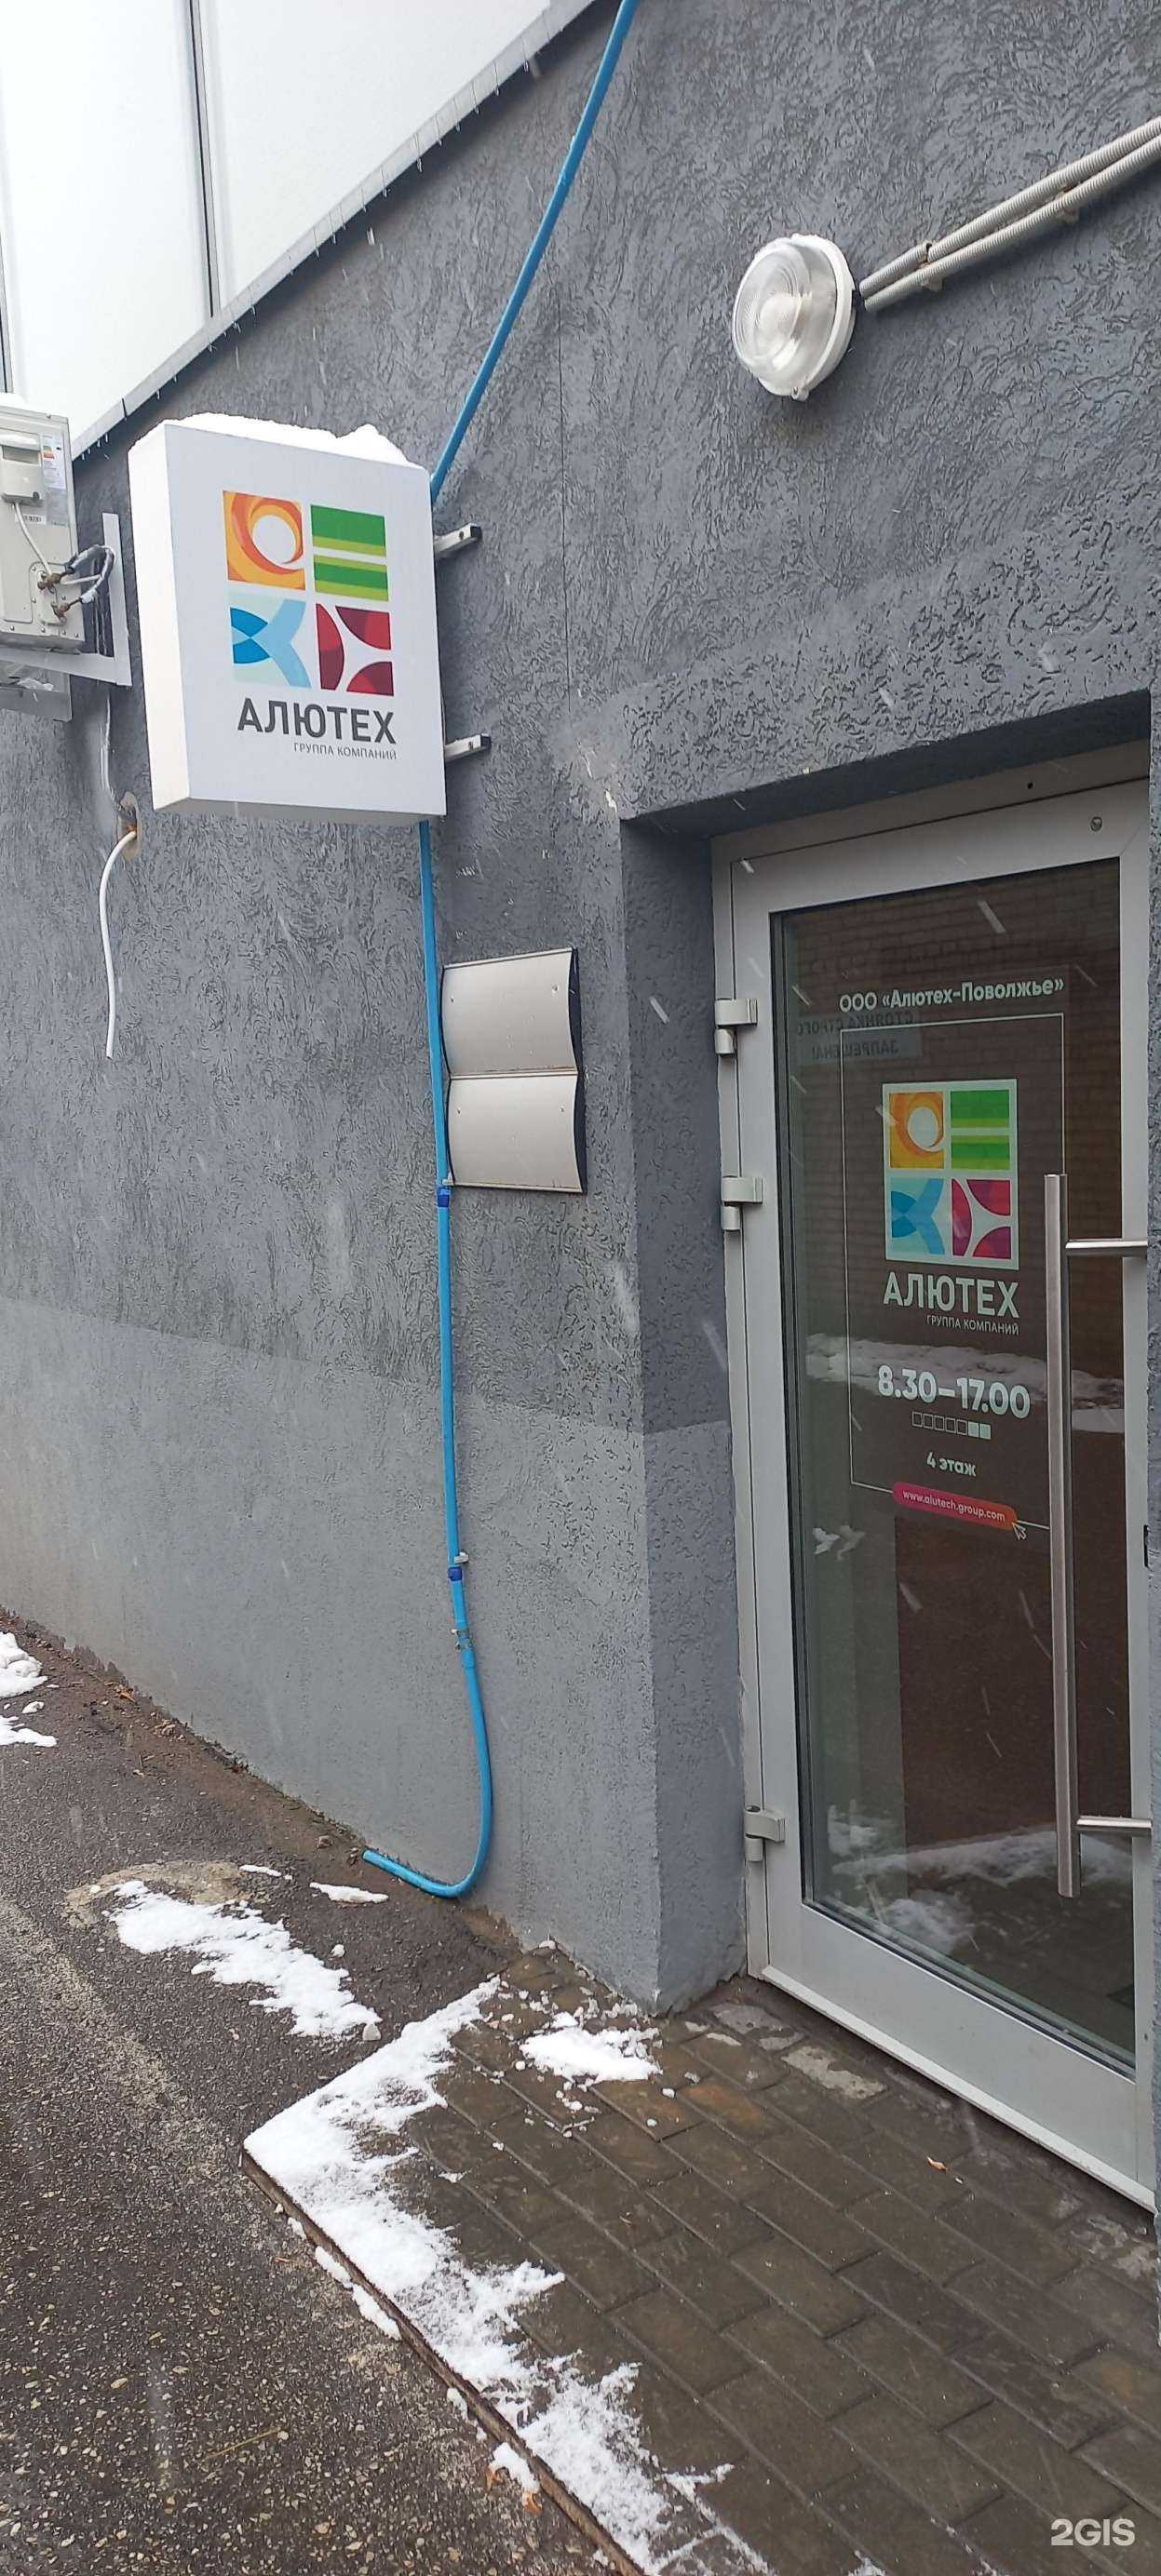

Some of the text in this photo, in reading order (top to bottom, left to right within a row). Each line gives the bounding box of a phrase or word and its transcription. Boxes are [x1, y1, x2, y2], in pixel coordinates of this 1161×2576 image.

[237, 697, 397, 745] АЛЮТЕХ
[293, 742, 397, 760] ГРУППА КОМПАНИЙ
[839, 977, 1064, 1013] ООО «Алютех-Поволжье»
[883, 1271, 1019, 1319] АЛЮТЕХ
[926, 1314, 1019, 1336] ГРУППА КОМПАНИЙ
[926, 1451, 977, 1477] 4 этаж
[902, 1489, 1006, 1523] www.alutech.group.com
